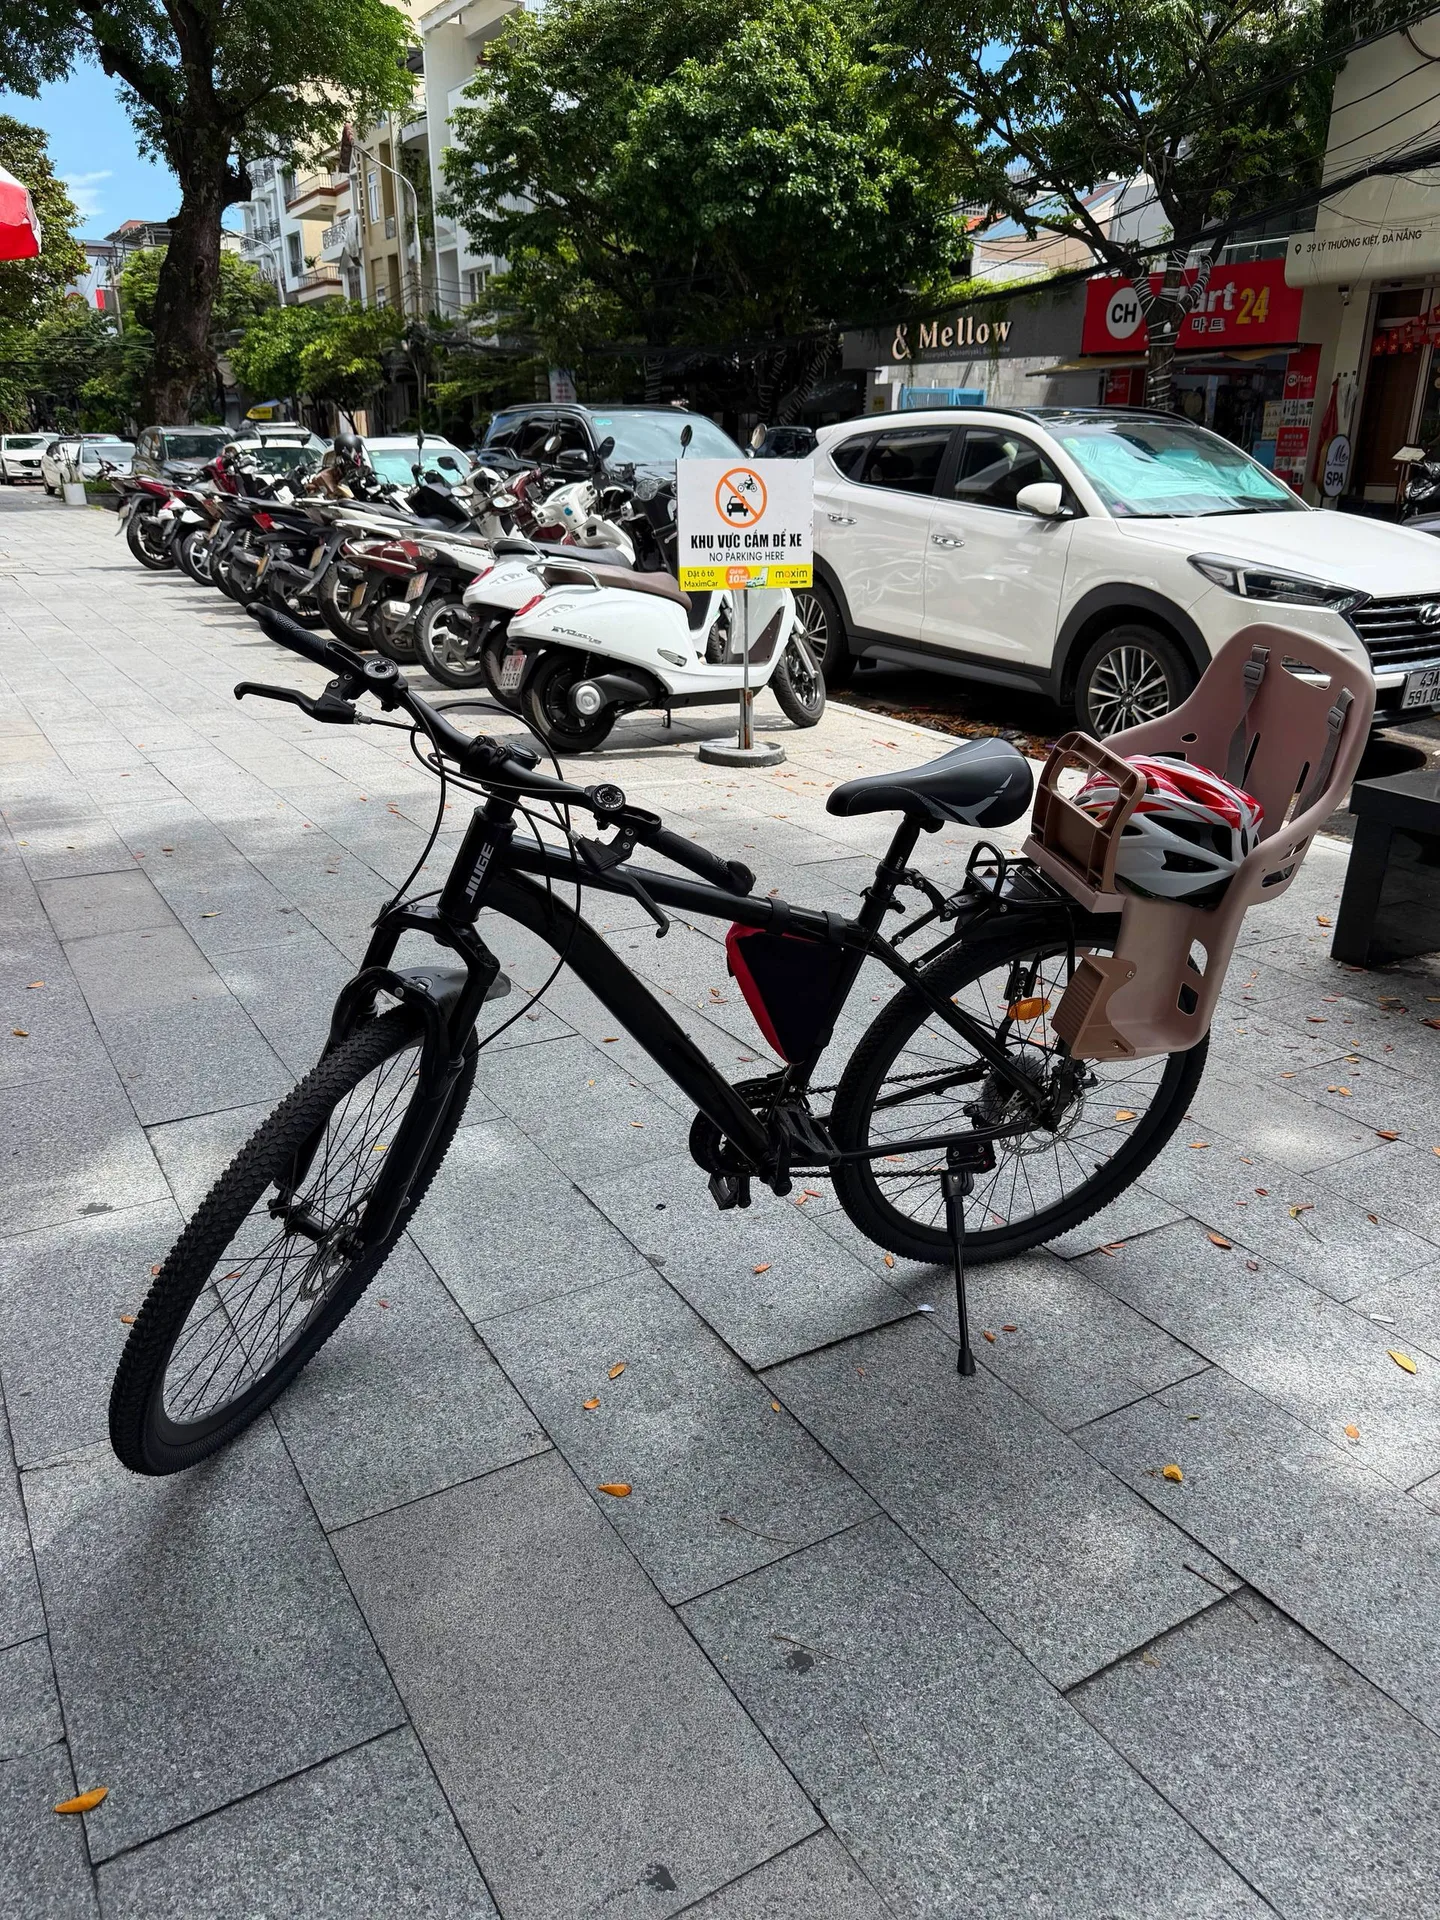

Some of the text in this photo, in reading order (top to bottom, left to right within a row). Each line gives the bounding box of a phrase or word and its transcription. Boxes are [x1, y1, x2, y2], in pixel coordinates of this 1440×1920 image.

[1306, 243, 1317, 253] 39
[1317, 240, 1326, 252] LÝ
[1111, 303, 1137, 324] CH
[1235, 286, 1271, 325] 24
[1191, 316, 1226, 334] 마트
[891, 316, 1012, 360] & Mellow
[1325, 471, 1344, 487] SPA
[691, 534, 714, 549] KHU
[717, 532, 741, 551] VỰC
[744, 529, 769, 548] CẤM
[789, 533, 802, 547] XE
[709, 551, 785, 562] NO PARKING HERE
[775, 567, 808, 578] maxim
[684, 579, 719, 588] MaximCar
[1420, 671, 1440, 688] 43A
[465, 842, 495, 904] JIUGE
